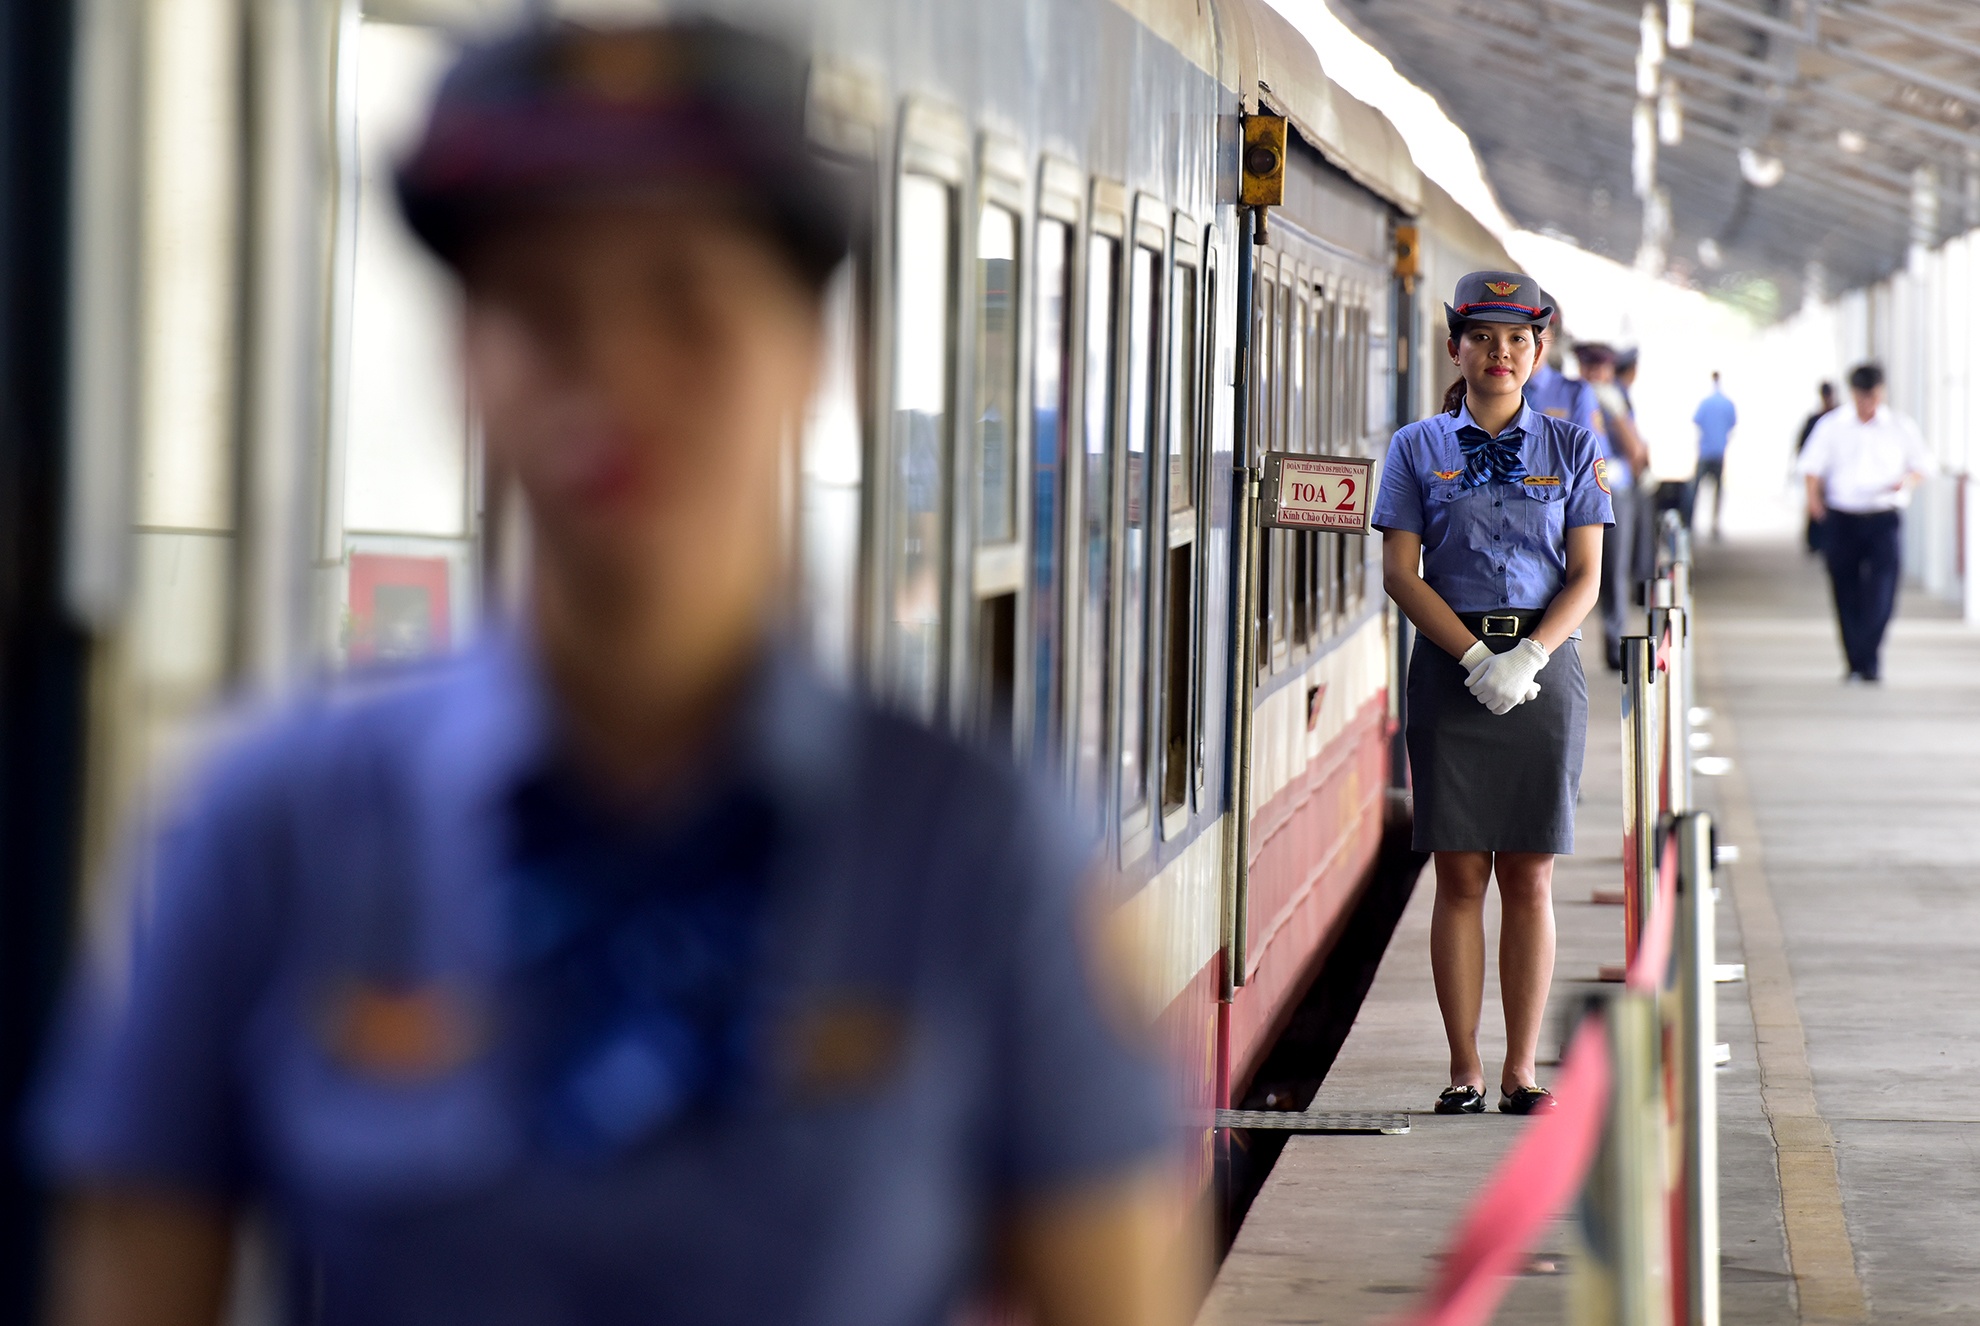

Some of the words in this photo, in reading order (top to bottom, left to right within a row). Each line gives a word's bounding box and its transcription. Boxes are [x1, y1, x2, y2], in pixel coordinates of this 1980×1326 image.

[1291, 482, 1327, 503] TOA
[1335, 478, 1356, 511] 2
[1282, 510, 1300, 521] Kính
[1301, 511, 1320, 522] Chào
[1321, 513, 1336, 526] Quý
[1337, 514, 1361, 525] Khách
